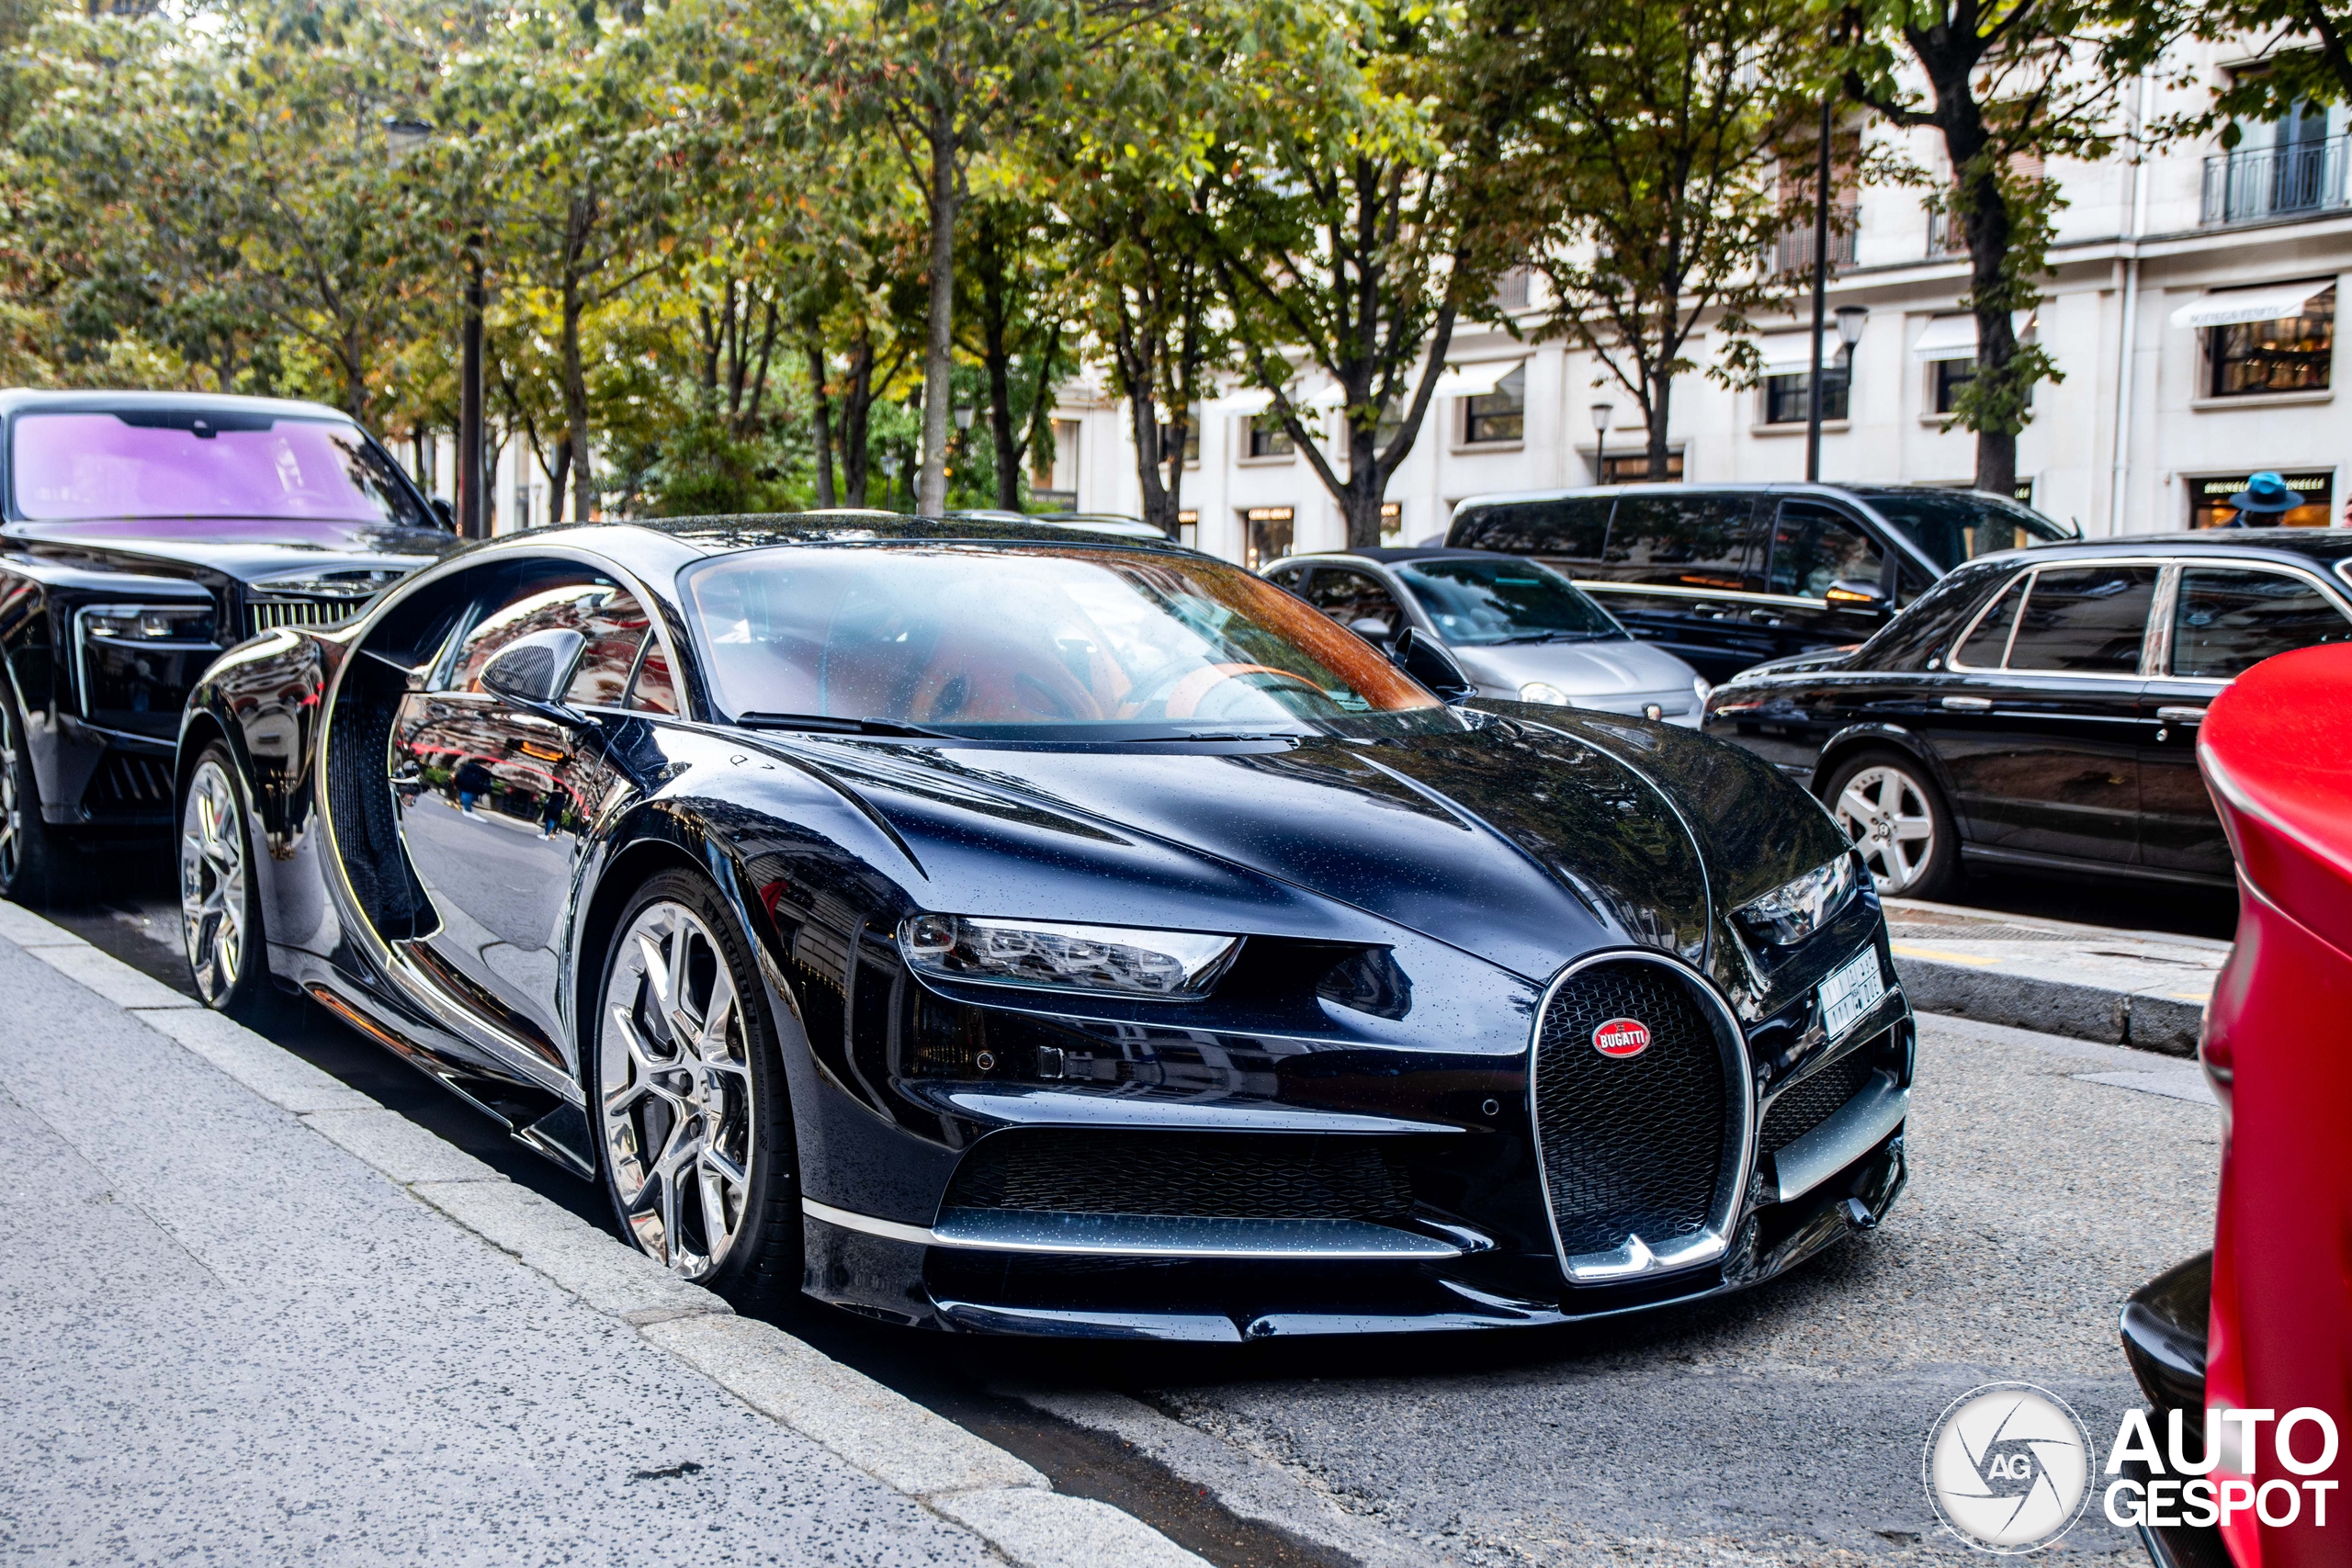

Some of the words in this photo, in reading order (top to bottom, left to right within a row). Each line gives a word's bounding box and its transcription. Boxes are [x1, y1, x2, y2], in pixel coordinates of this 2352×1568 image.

[716, 919, 756, 1018] MICHELIN
[753, 1033, 763, 1066] PILOT
[758, 1072, 766, 1111] SPORT
[1600, 1030, 1645, 1048] BUGATTI
